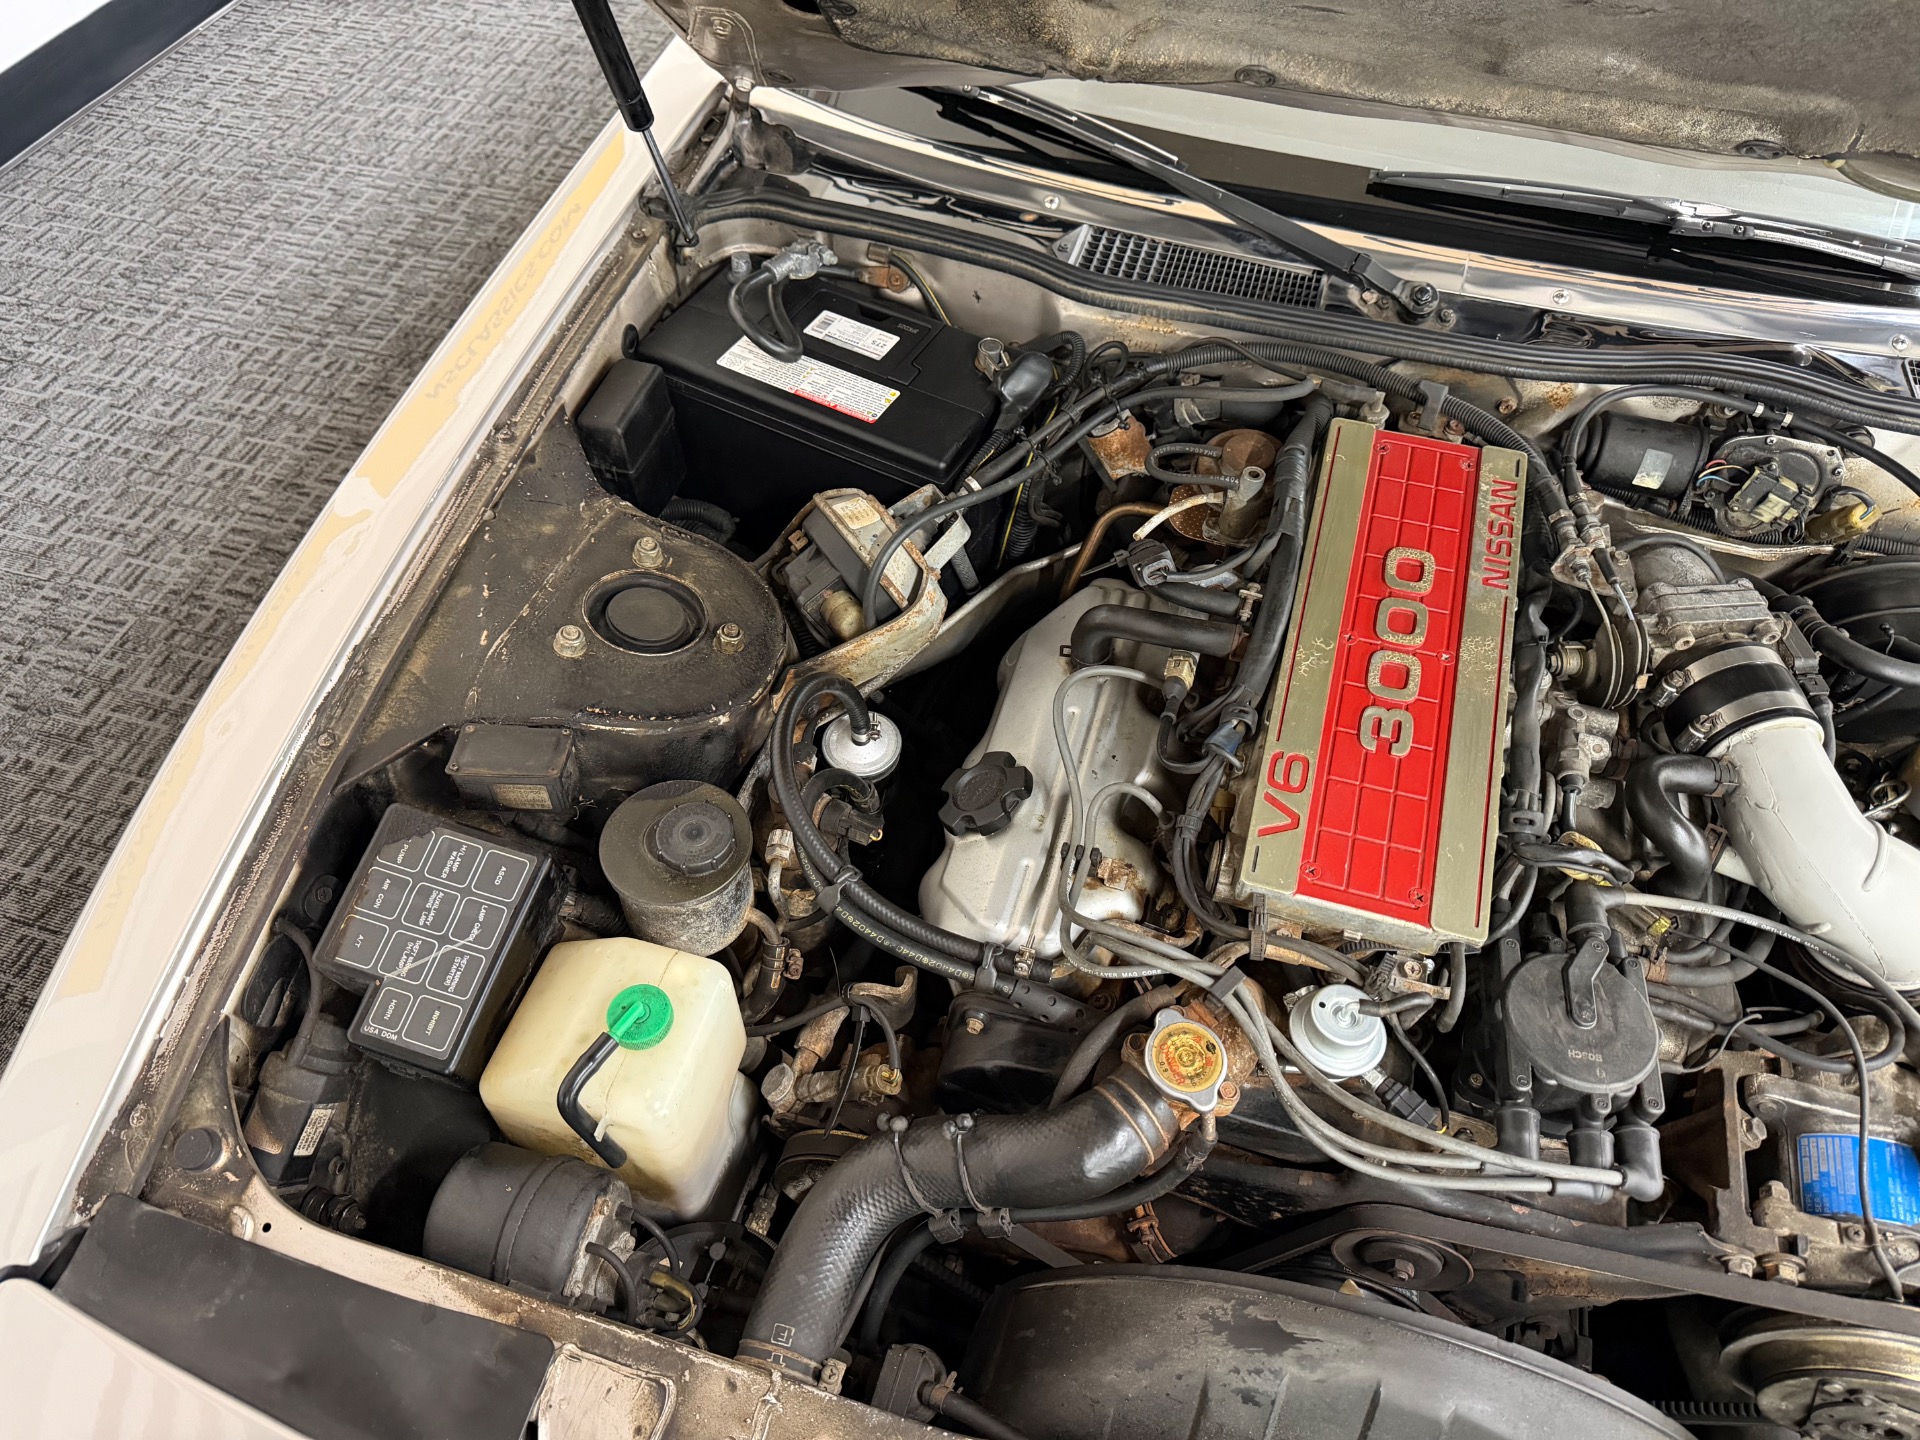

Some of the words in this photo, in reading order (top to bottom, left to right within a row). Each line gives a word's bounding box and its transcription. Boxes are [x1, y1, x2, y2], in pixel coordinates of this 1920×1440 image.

[1481, 479, 1518, 590] NISSAN
[1359, 546, 1436, 759] 3000
[1257, 750, 1310, 837] V6
[397, 843, 409, 864] PUMP
[452, 844, 468, 873] H/LAMP
[440, 850, 458, 879] WASHER
[382, 878, 391, 891] AIR
[494, 865, 507, 886] ASCD
[373, 893, 384, 909] CON
[425, 891, 445, 926] AUXILIARY
[478, 904, 488, 922] LAMP
[355, 934, 364, 949] A/T
[468, 922, 481, 942] CHECK
[1760, 923, 1802, 944] OPTI-LAYER
[411, 940, 422, 957] THEFT
[443, 956, 462, 987] (STARTER)
[459, 954, 470, 971] THEFT
[1142, 968, 1162, 976] CORE
[447, 971, 462, 993] WARNING
[383, 999, 398, 1021] HORN
[363, 1025, 379, 1036] USA
[380, 1030, 398, 1041] DOM
[424, 1010, 441, 1036] INHIBIT
[1567, 1049, 1603, 1062] BOSCH
[1805, 1192, 1813, 1213] TYPE
